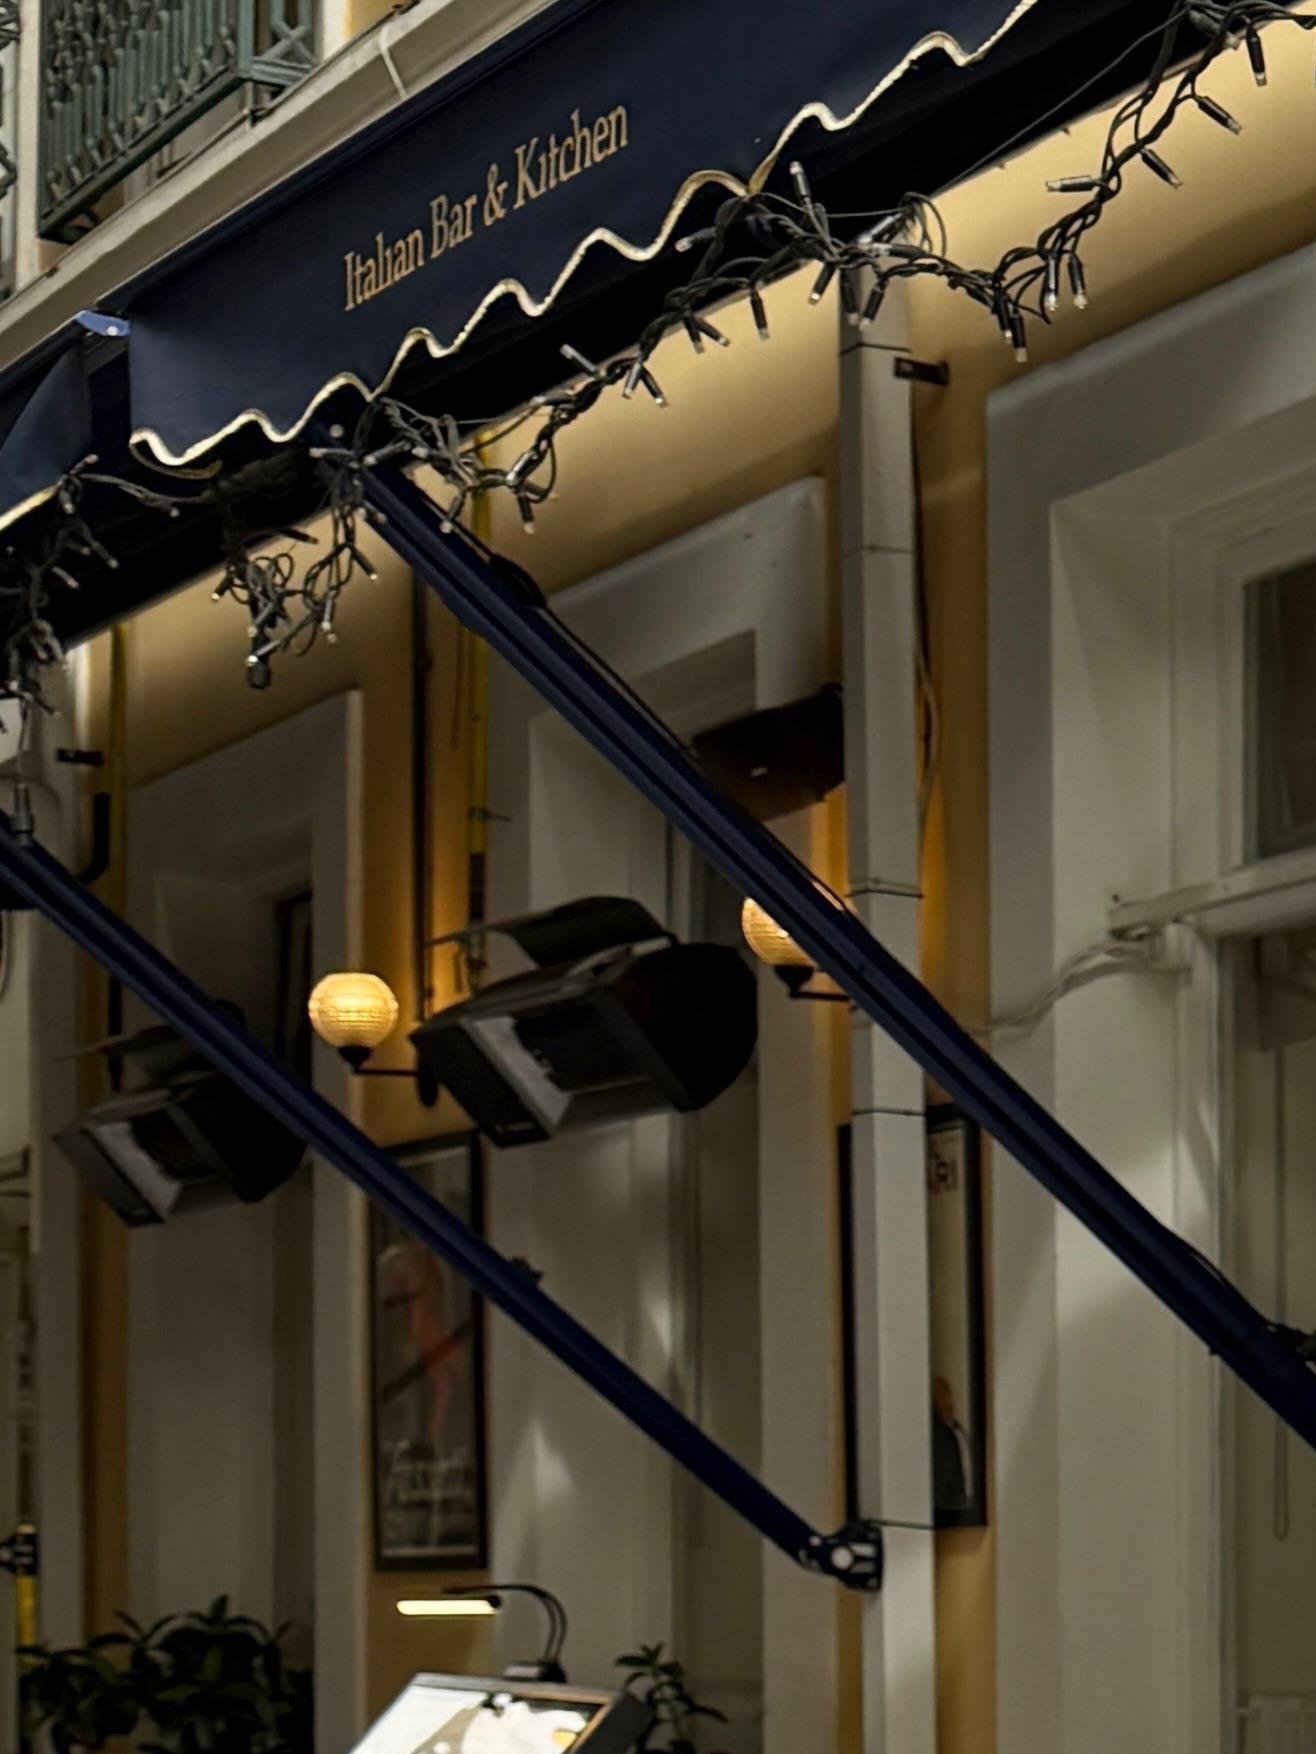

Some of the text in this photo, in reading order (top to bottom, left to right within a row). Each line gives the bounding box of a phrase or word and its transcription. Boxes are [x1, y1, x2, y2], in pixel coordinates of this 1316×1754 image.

[344, 105, 628, 311] Italian Bar & Kitchen
